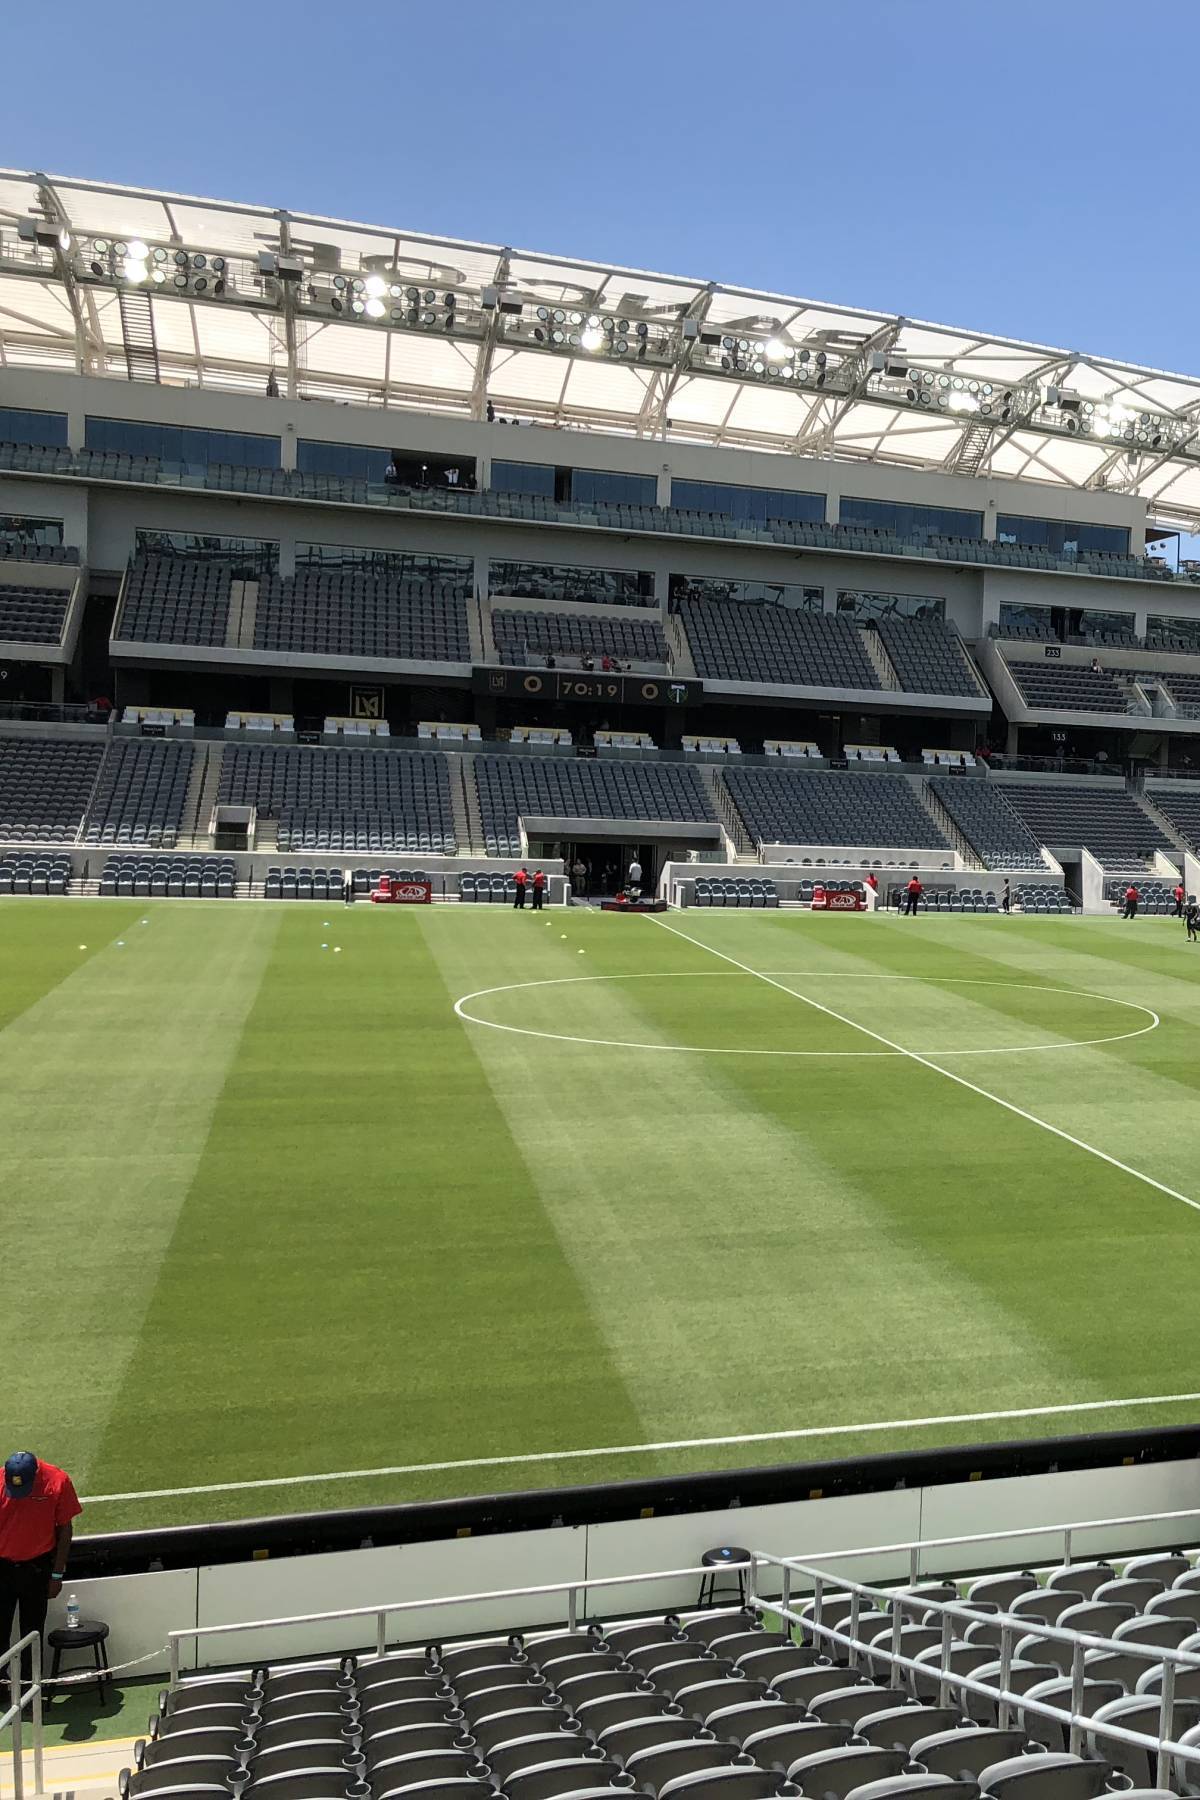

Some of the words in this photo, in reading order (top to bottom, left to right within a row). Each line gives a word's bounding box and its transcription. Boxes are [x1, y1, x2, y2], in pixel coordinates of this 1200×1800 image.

[524, 676, 542, 692] 0
[562, 682, 617, 696] 70:19
[641, 683, 658, 699] 0
